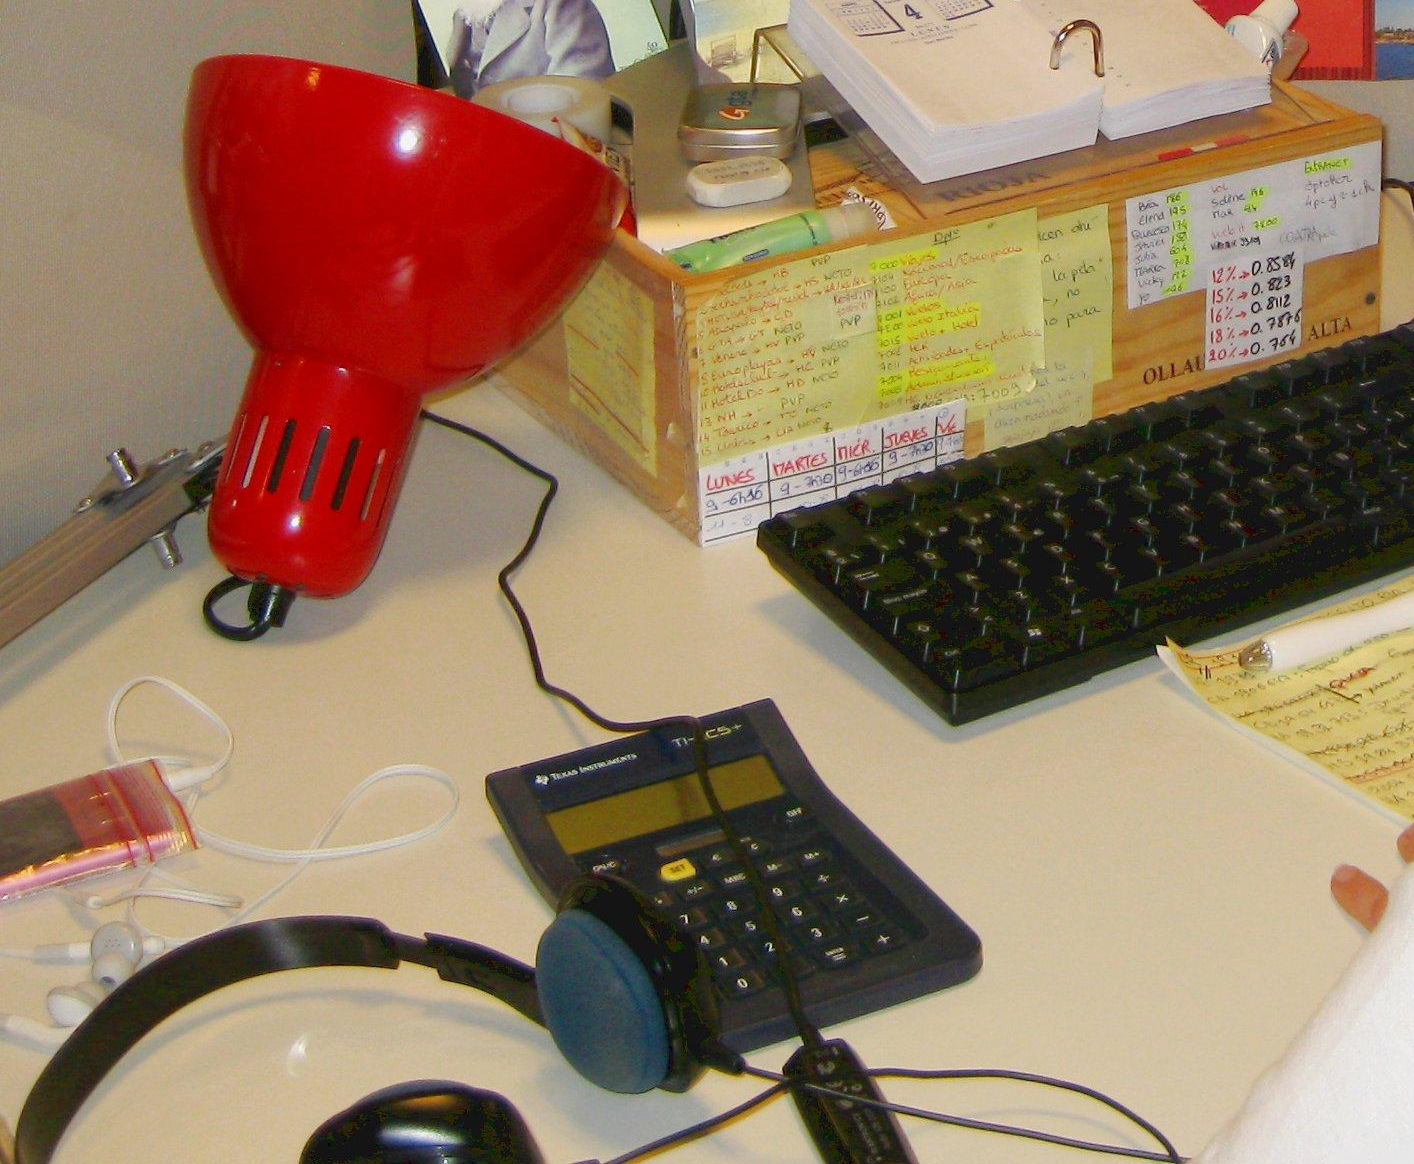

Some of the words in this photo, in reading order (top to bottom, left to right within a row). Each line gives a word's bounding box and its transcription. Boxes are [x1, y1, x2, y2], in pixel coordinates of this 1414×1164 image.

[904, 3, 923, 20] 4
[1212, 265, 1237, 284] 12%
[1212, 286, 1235, 305] 15%
[1210, 305, 1233, 323] 16%
[1210, 326, 1236, 344] 18%
[1142, 354, 1206, 386] OLLAU
[1308, 316, 1353, 342] ALTA
[1209, 344, 1237, 362] 20%
[706, 468, 756, 492] LUNES
[772, 451, 828, 477] MARTES
[884, 426, 928, 450] JUEVES
[549, 768, 577, 783] TEXAS
[772, 887, 784, 898] 9
[726, 900, 738, 912] 8
[791, 906, 803, 917] 6
[679, 913, 690, 925] 7
[744, 920, 757, 932] 5
[810, 927, 823, 938] 3
[700, 935, 711, 946] 4
[764, 941, 776, 953] 2
[718, 956, 729, 968] 1
[737, 977, 749, 989] 0
